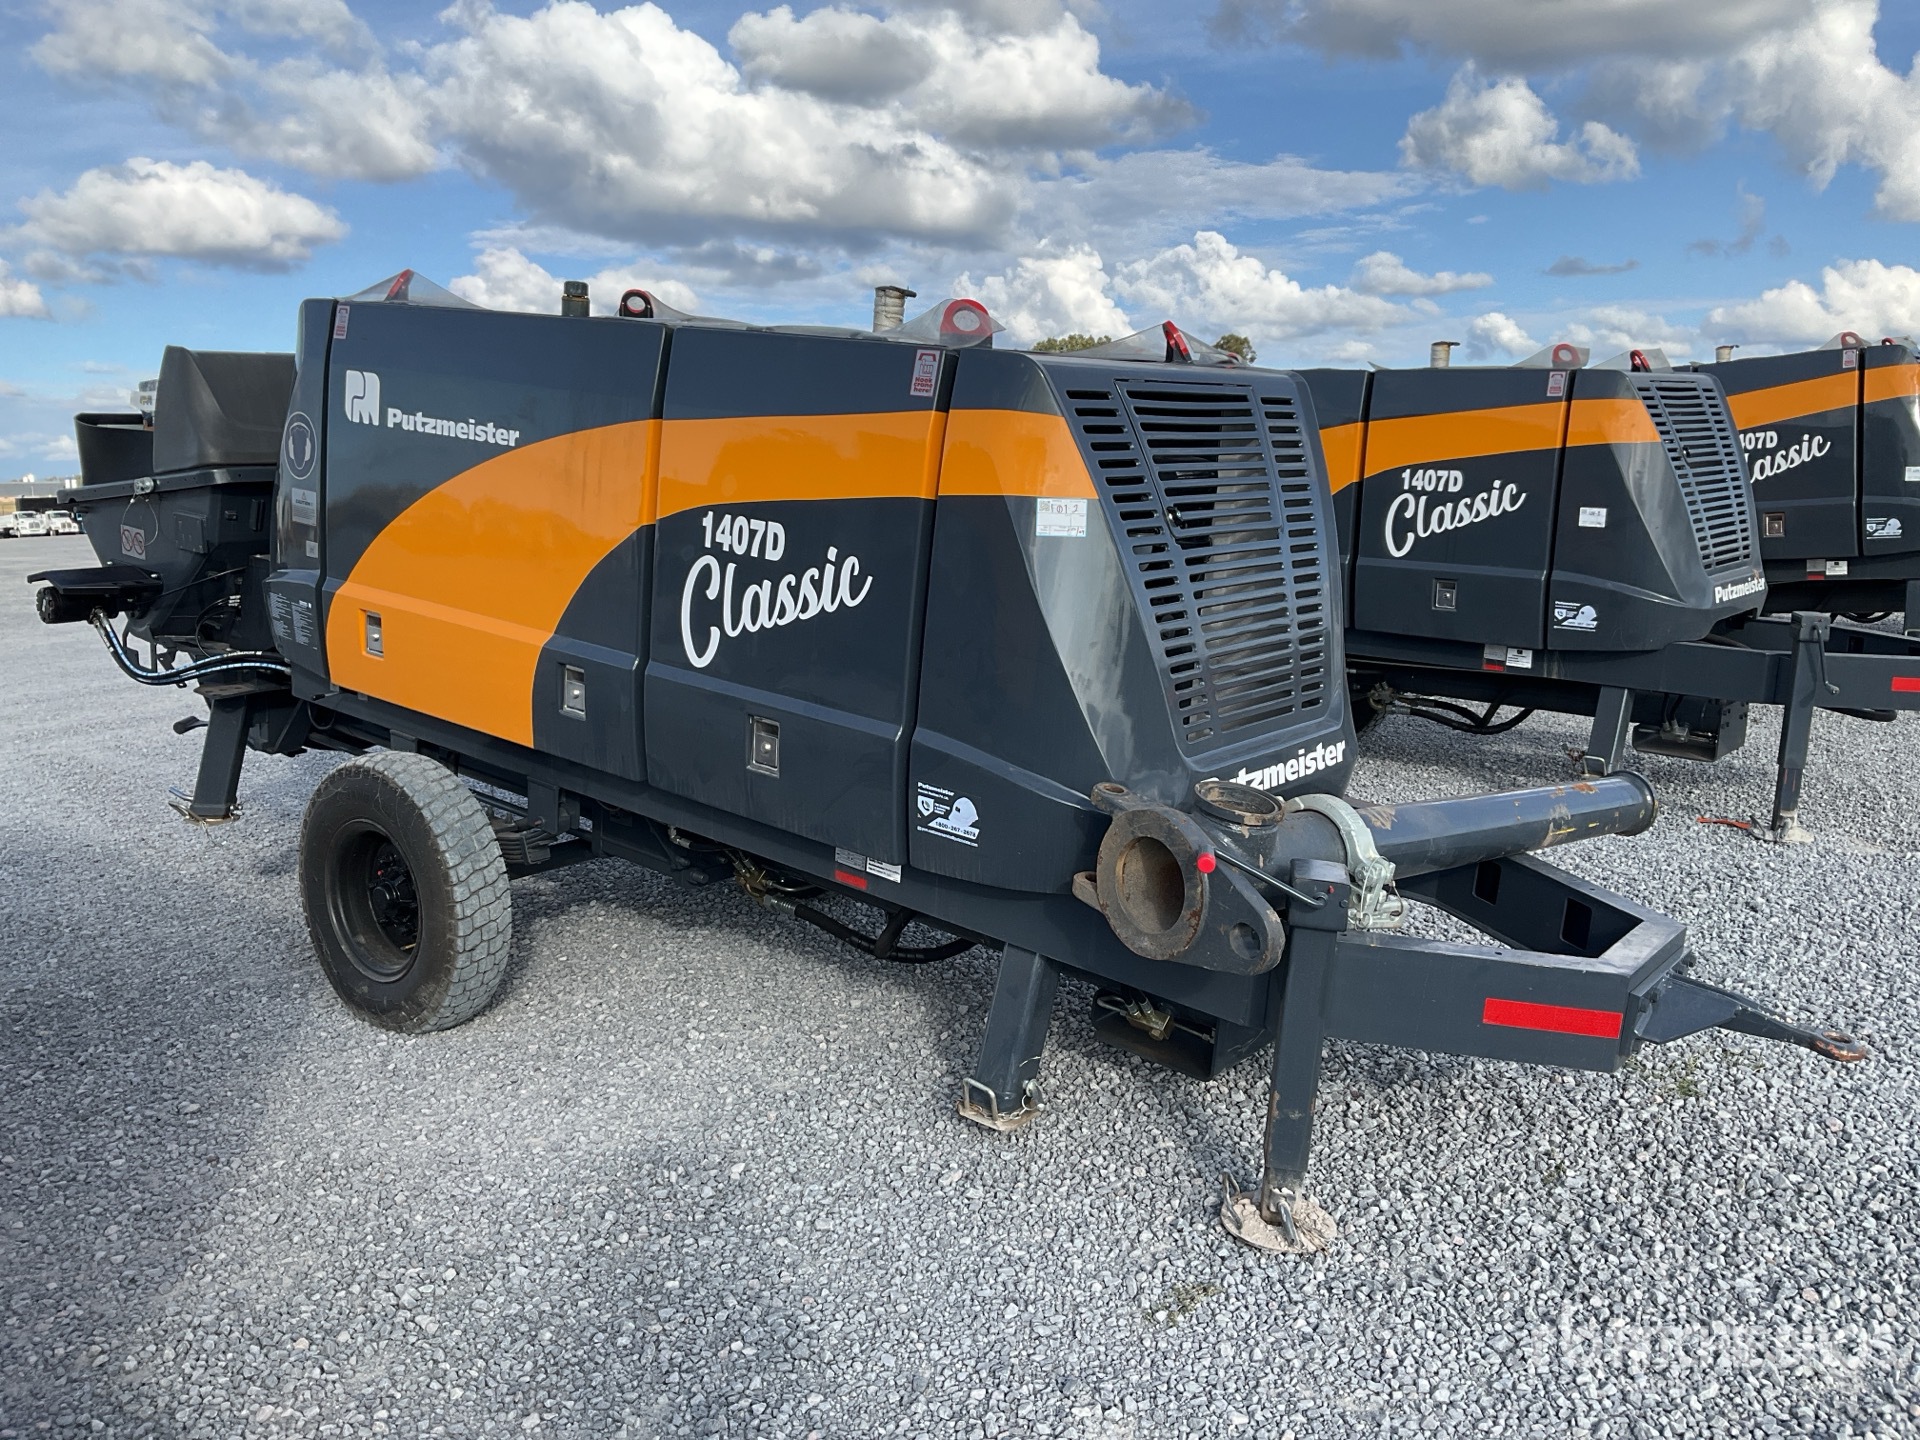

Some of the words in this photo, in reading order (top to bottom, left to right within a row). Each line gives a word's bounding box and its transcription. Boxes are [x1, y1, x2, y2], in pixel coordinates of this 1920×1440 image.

[387, 407, 520, 447] Putzmeister
[1401, 468, 1463, 492] 1407D
[702, 510, 786, 562] 1407D
[1385, 479, 1527, 558] Classic
[681, 546, 873, 668] Classic
[1714, 577, 1766, 604] Putzmeister
